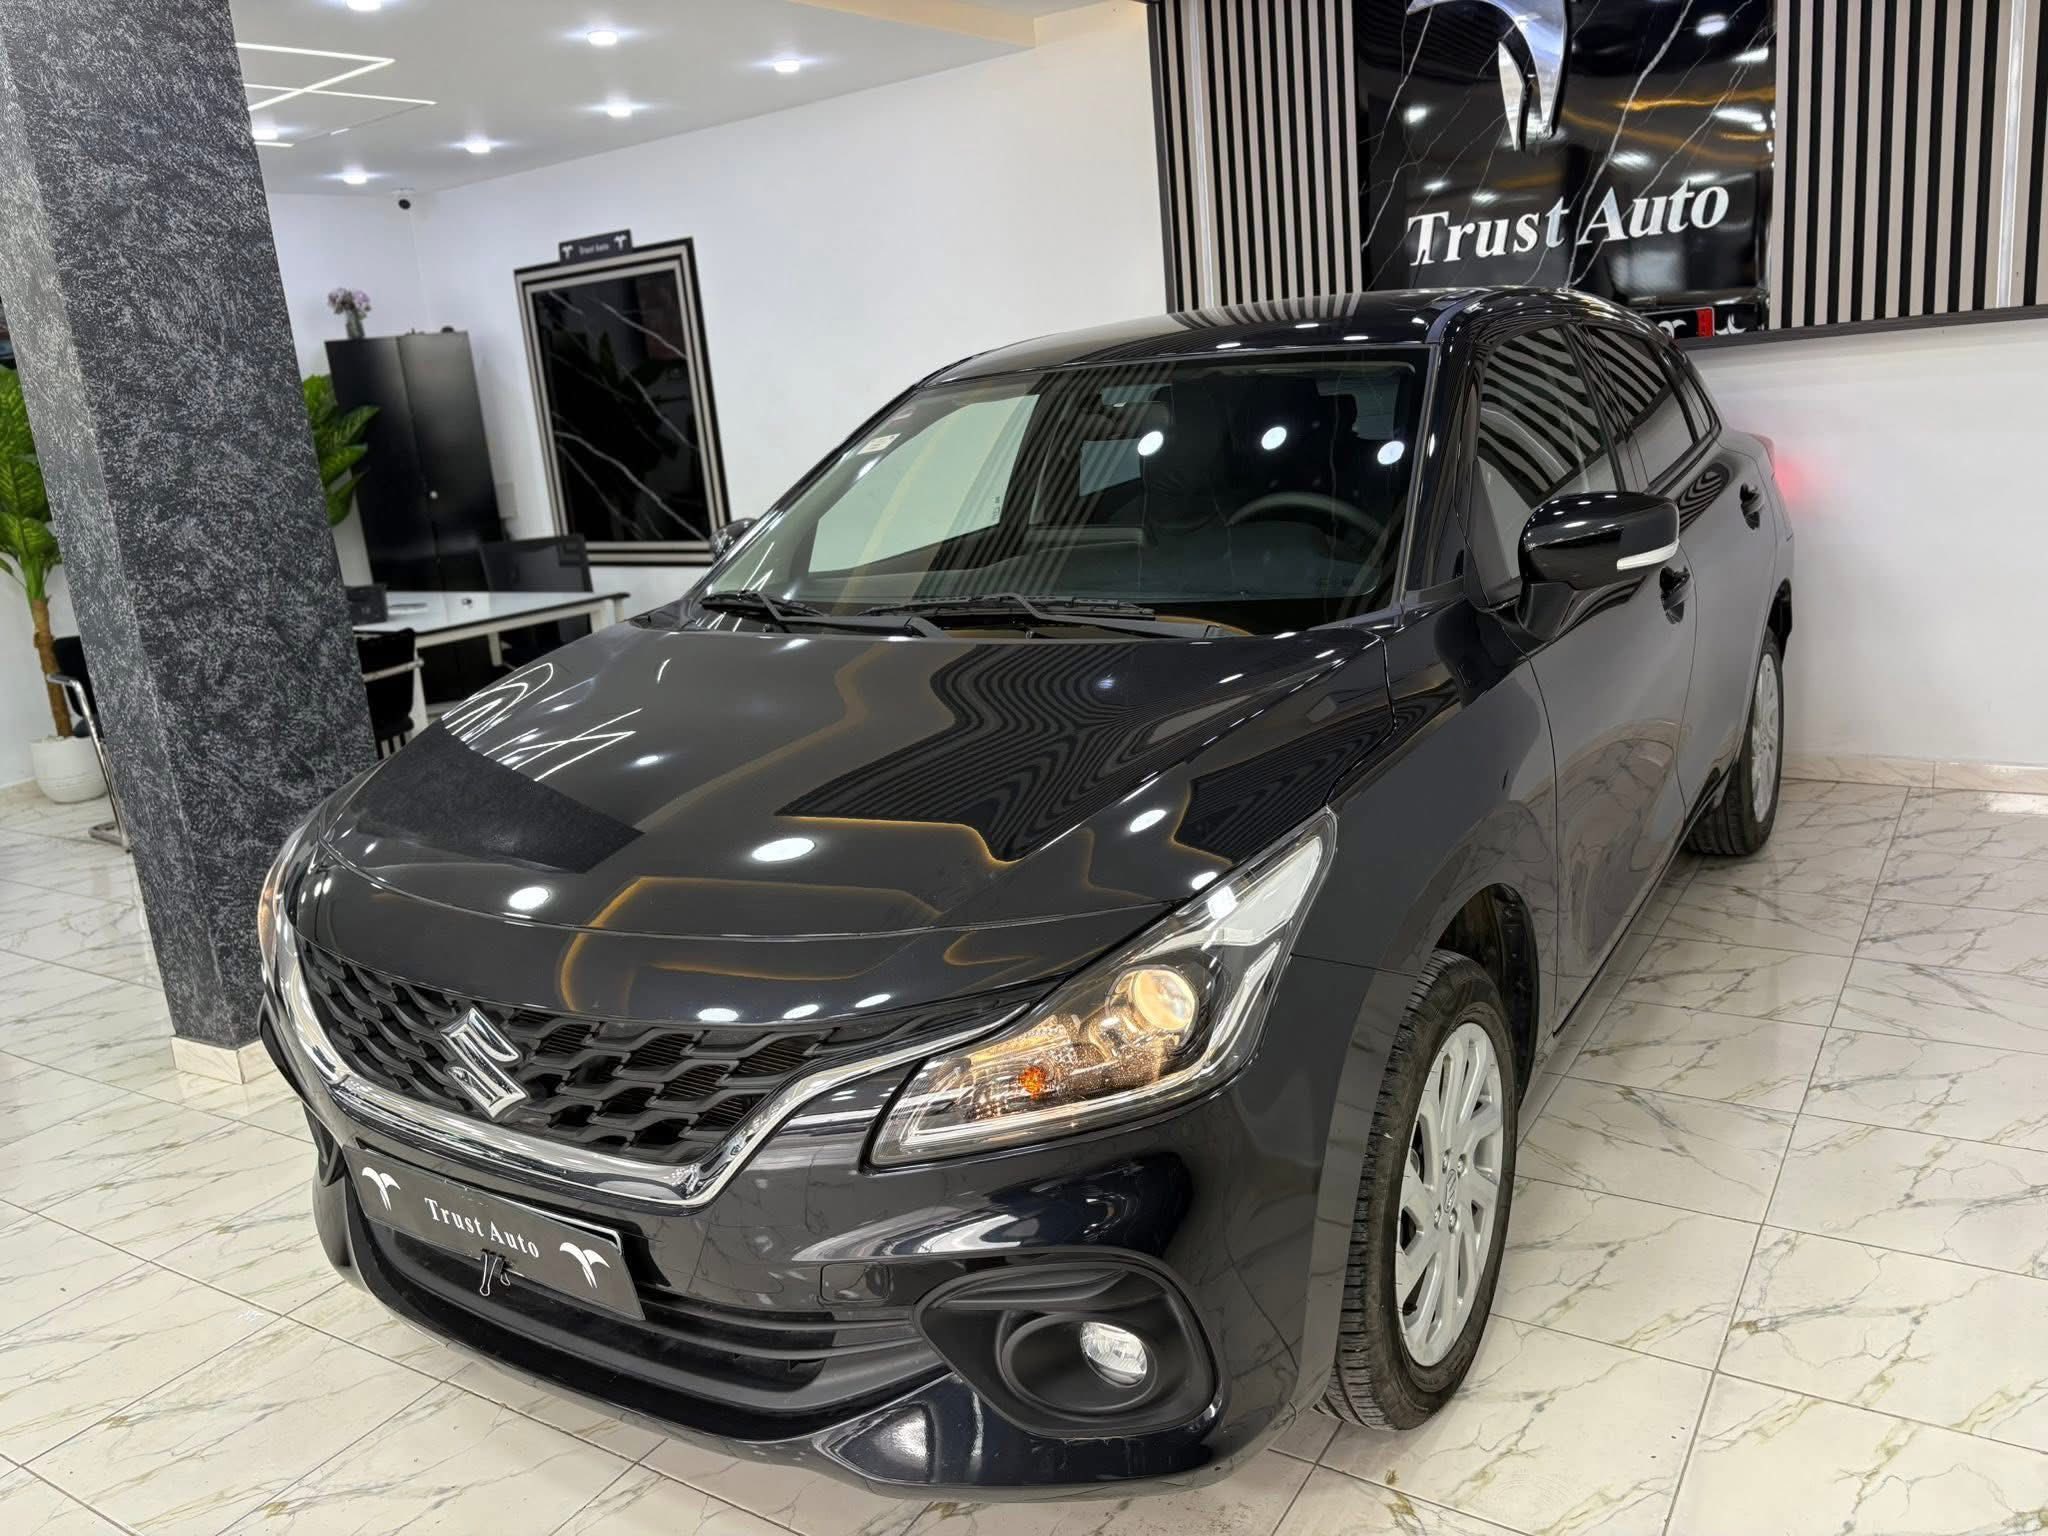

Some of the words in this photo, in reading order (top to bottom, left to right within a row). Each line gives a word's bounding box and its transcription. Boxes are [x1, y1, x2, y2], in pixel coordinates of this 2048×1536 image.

[1407, 196, 1569, 266] Trust
[1576, 180, 1729, 246] Auto
[424, 1197, 484, 1237] Trust
[489, 1221, 540, 1258] Auto
